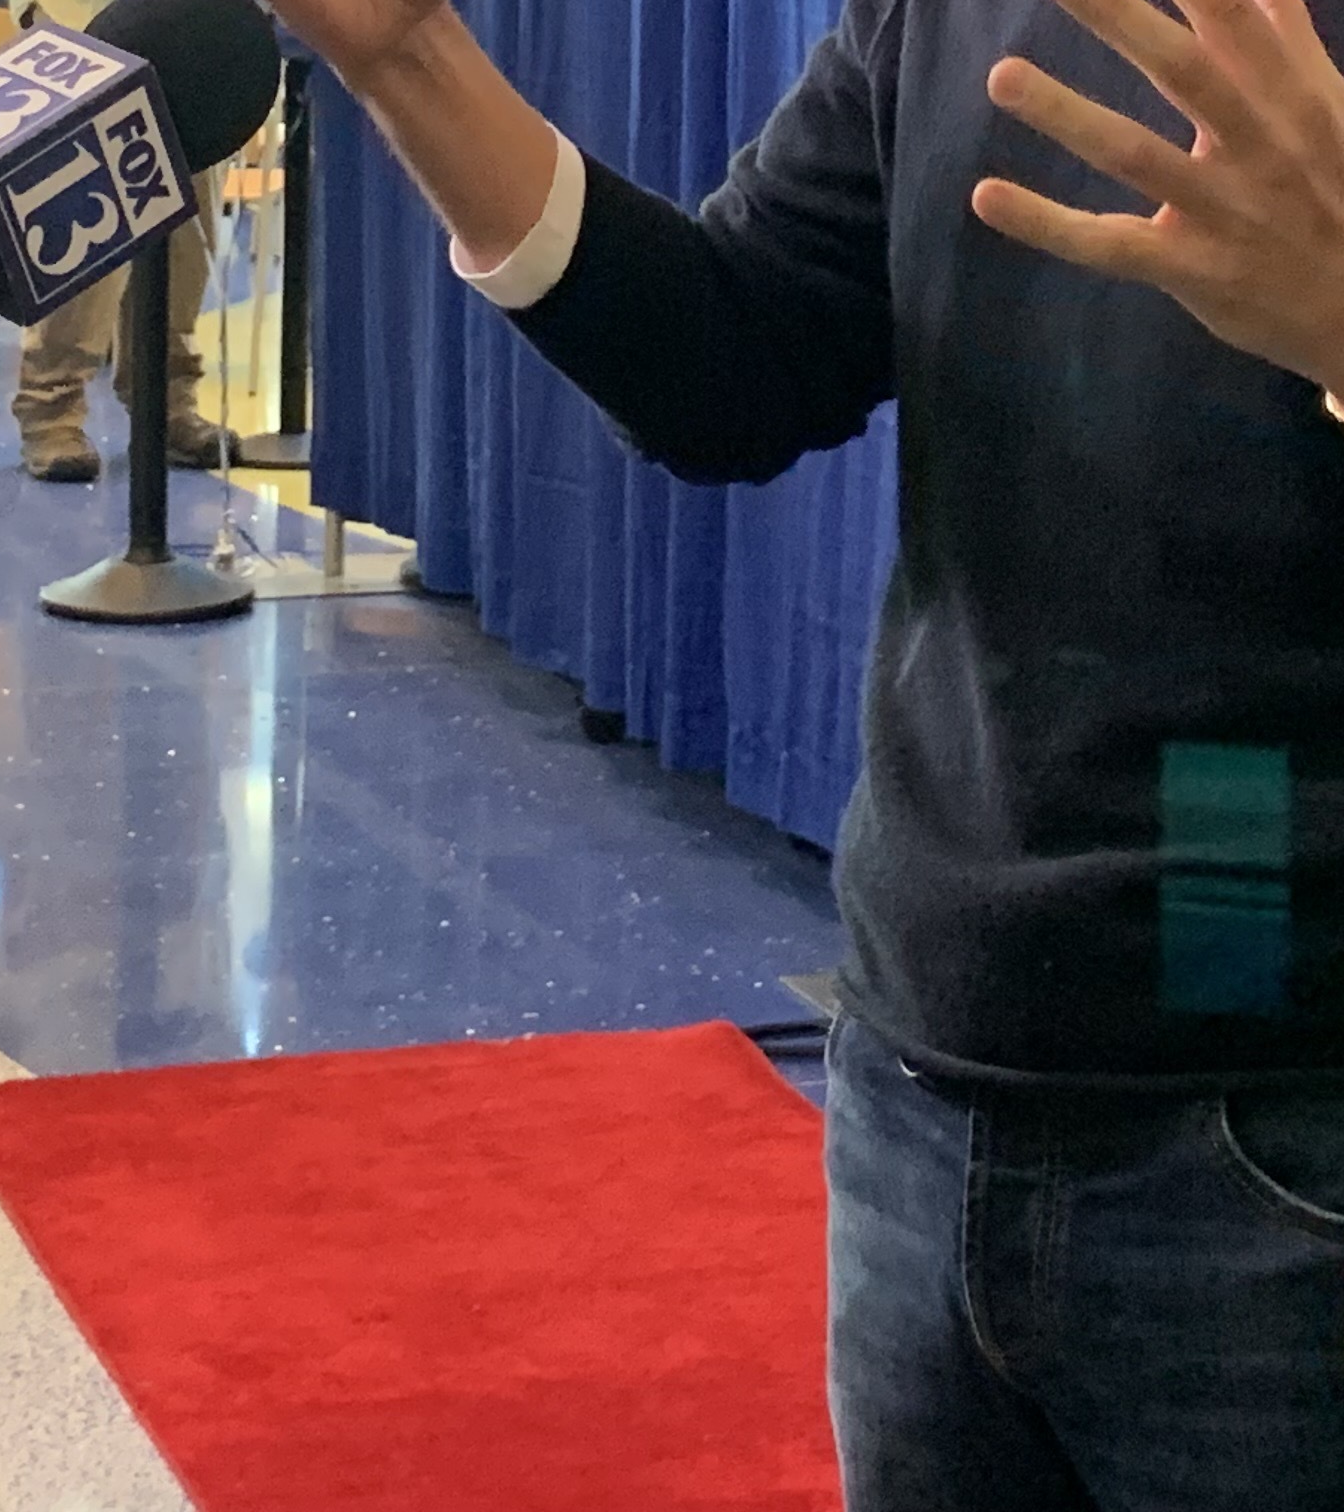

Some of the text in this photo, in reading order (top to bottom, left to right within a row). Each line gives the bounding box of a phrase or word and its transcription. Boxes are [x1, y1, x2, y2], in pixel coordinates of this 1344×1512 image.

[10, 40, 104, 89] FOX
[7, 139, 121, 277] 13
[106, 108, 172, 220] FOX
